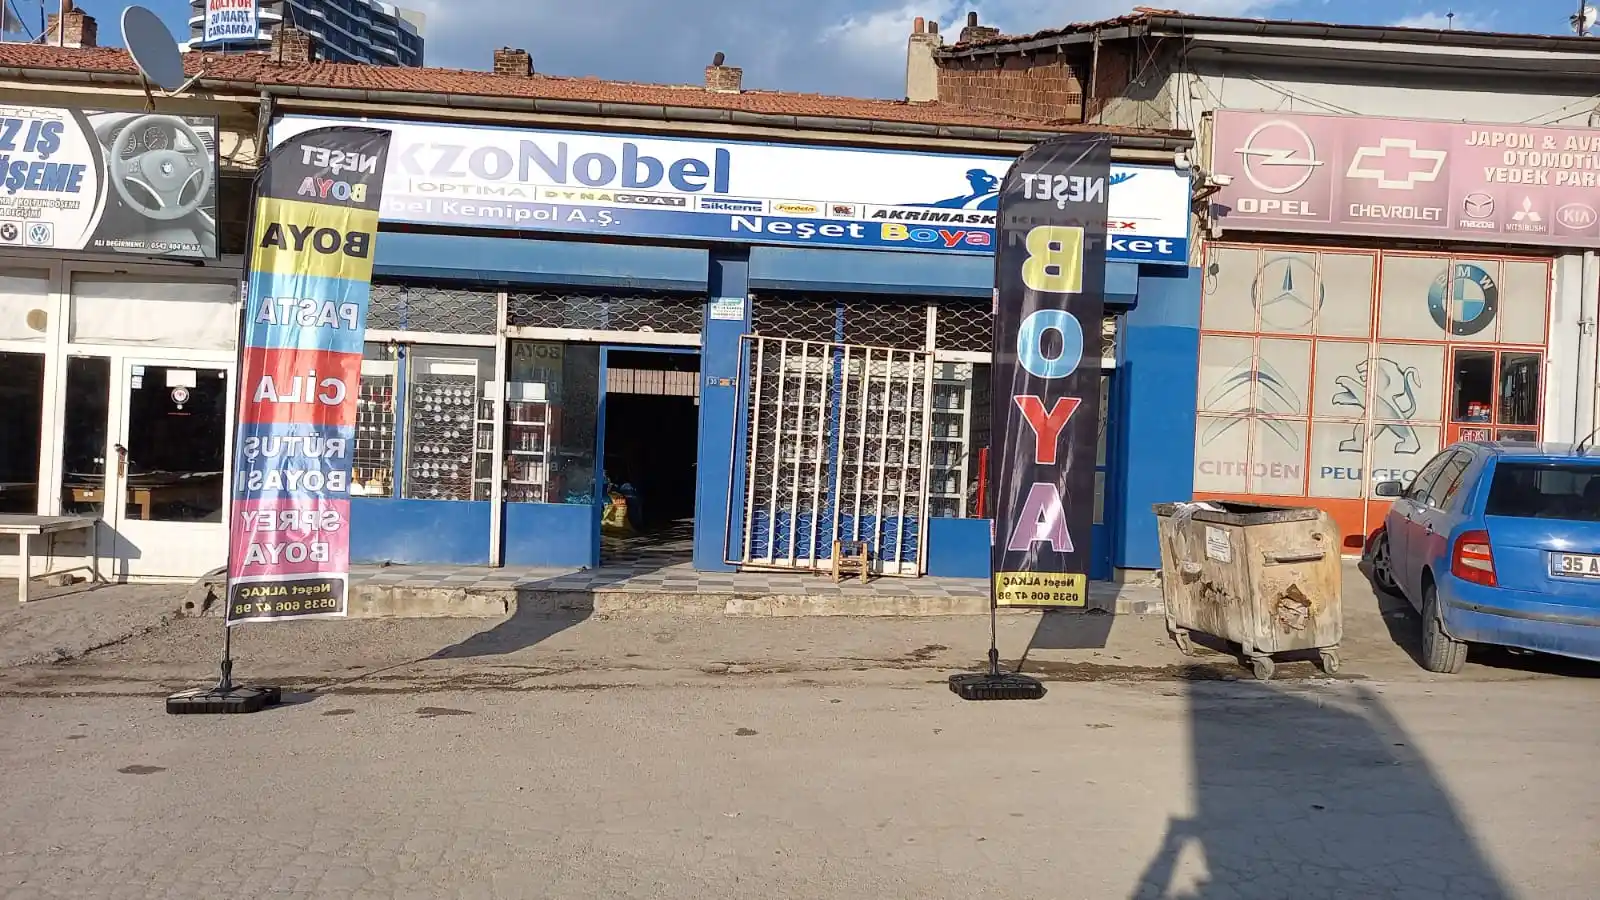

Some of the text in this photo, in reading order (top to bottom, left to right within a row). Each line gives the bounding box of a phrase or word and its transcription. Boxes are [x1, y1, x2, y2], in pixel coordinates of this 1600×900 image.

[221, 10, 250, 23] MART
[1465, 130, 1534, 149] JAPON
[1541, 135, 1557, 150] &
[393, 139, 731, 194] kzoNobel
[1484, 167, 1600, 187] YEDEK PAR
[442, 200, 557, 223] Kemipol
[566, 209, 621, 227] A.Ş.
[1236, 198, 1318, 216] OPEL
[1349, 203, 1443, 221] CHEVROLET
[730, 215, 865, 239] Neşet
[881, 222, 991, 248] Boya
[1460, 219, 1495, 229] mazda
[1198, 457, 1300, 479] CITROËN
[1320, 466, 1419, 482] PEUGEO
[1563, 556, 1583, 571] 35
